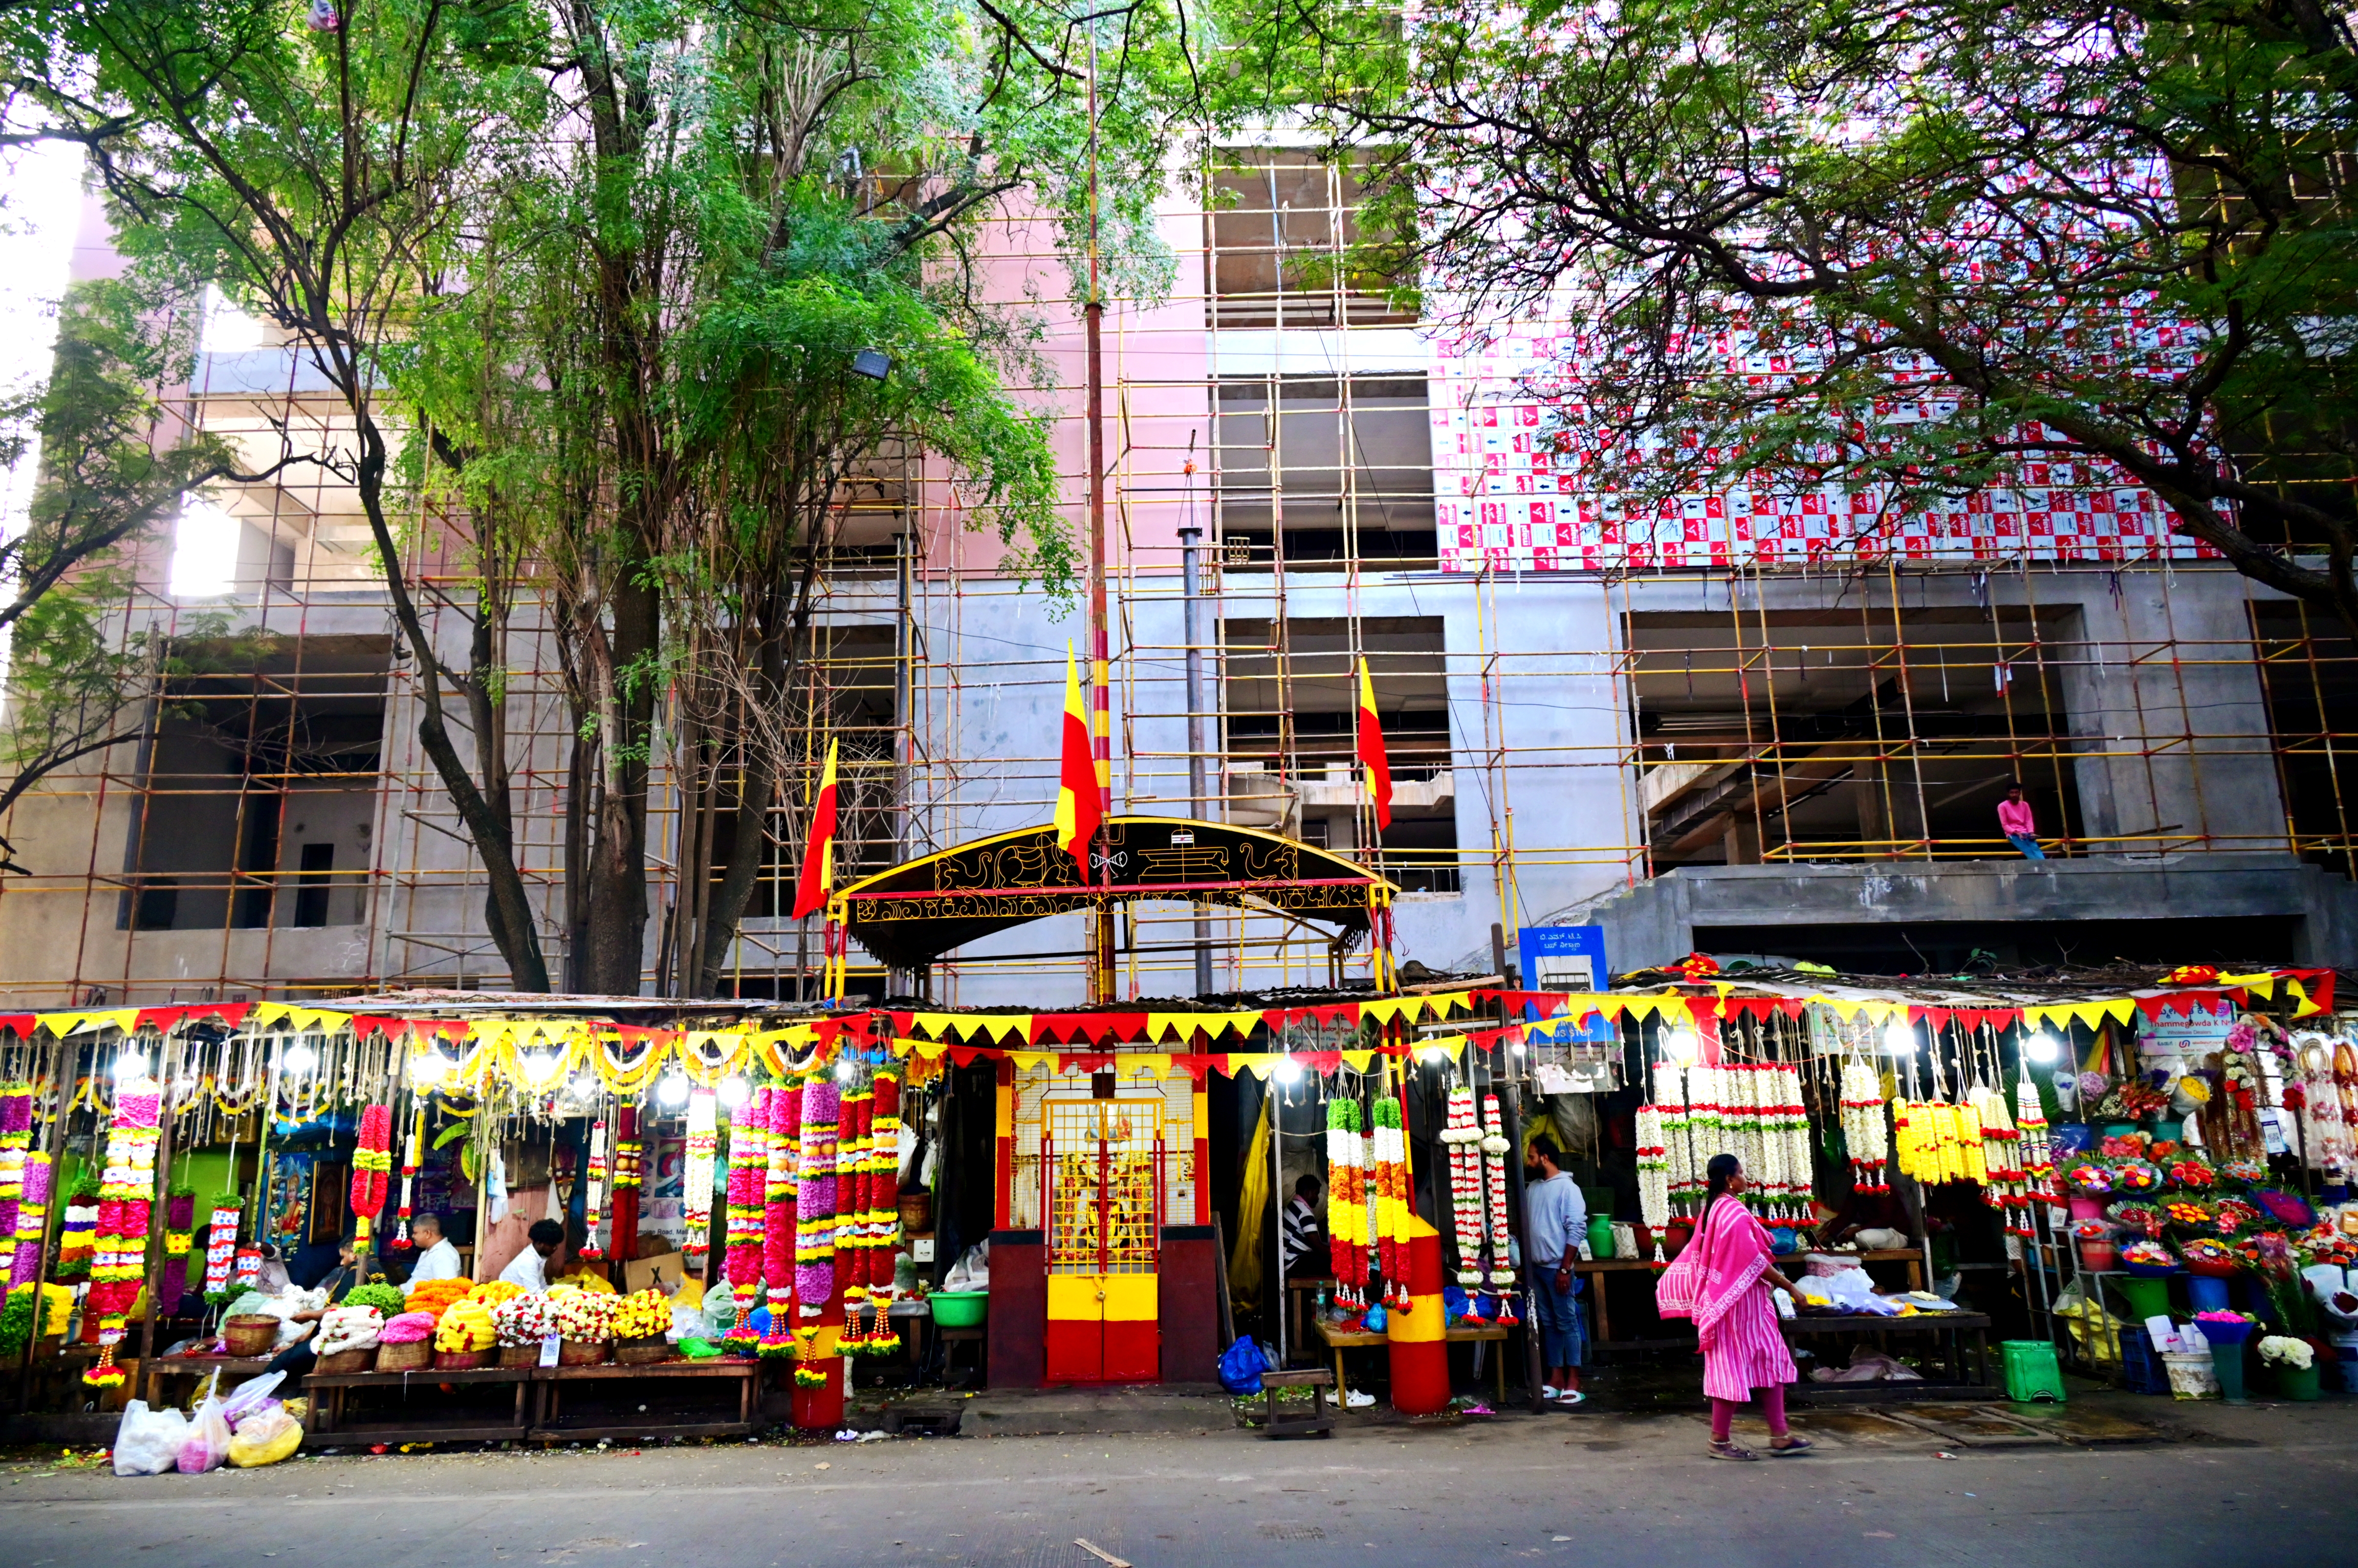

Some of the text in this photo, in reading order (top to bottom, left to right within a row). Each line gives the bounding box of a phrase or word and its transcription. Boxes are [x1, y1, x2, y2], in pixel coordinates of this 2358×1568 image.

[1696, 520, 1706, 540] mapl
[1793, 517, 1802, 537] mapl
[1958, 515, 1967, 535] mapl
[2007, 515, 2016, 535] mapl
[2131, 514, 2139, 534] mapl
[1520, 525, 1530, 546] mapl
[1569, 524, 1578, 545] mapl
[1570, 1029, 1593, 1037] STOP
